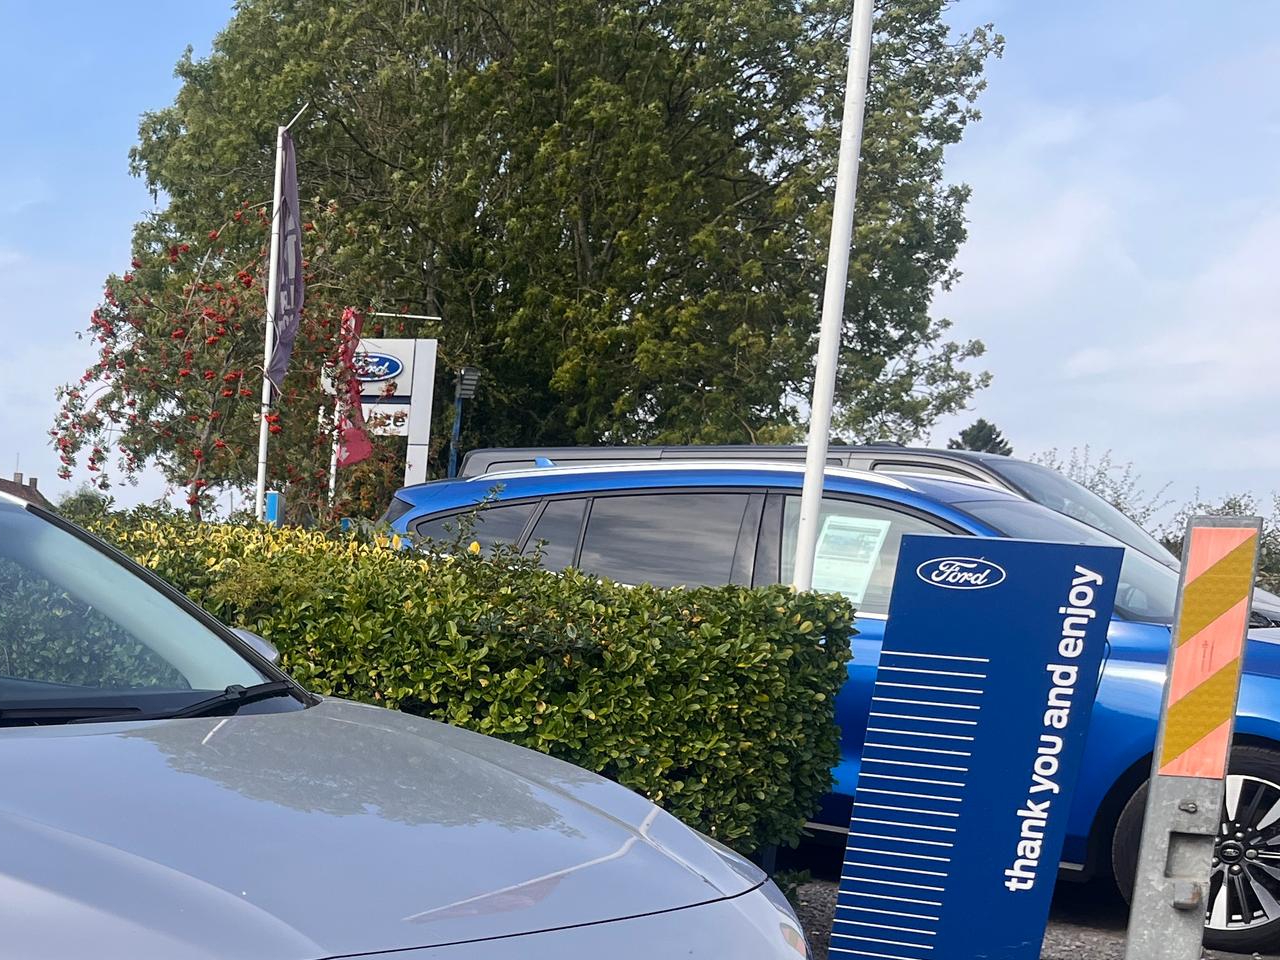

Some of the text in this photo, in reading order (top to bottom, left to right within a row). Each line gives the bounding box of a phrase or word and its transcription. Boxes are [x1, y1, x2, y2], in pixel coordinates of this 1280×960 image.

[931, 561, 992, 585] Ford
[1004, 565, 1103, 892] thank you and enjoy
